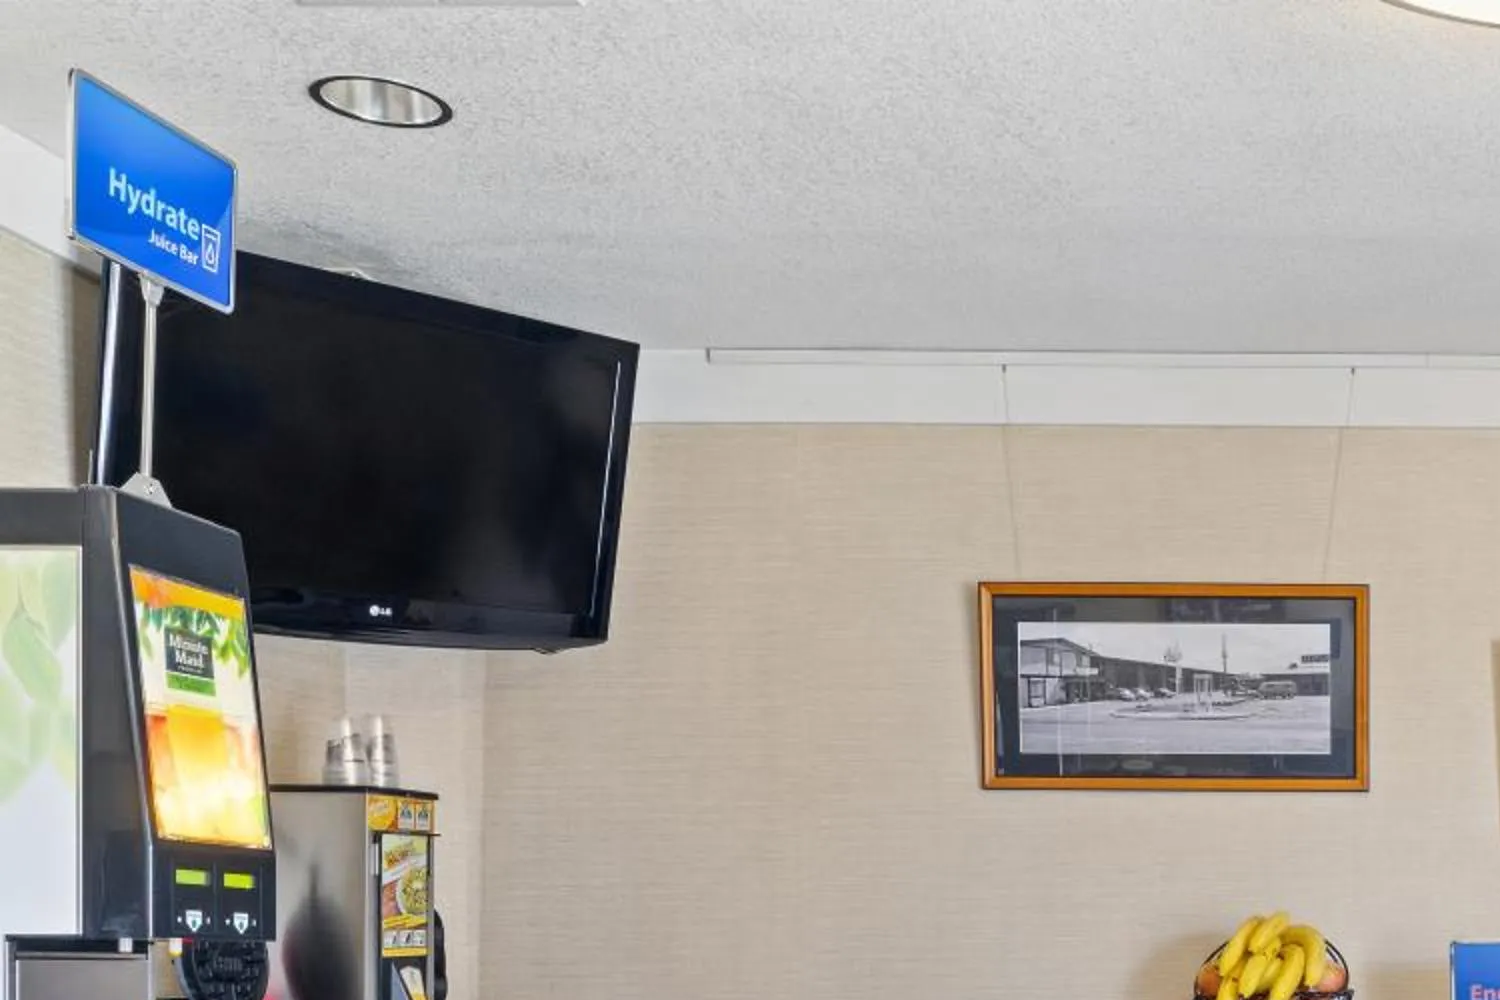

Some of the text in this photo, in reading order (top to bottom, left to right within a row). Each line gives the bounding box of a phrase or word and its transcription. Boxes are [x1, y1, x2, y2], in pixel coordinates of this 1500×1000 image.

[108, 167, 201, 241] Hydrate
[148, 229, 200, 266] Juice Bar
[169, 632, 209, 655] Minute
[175, 649, 204, 669] Maid
